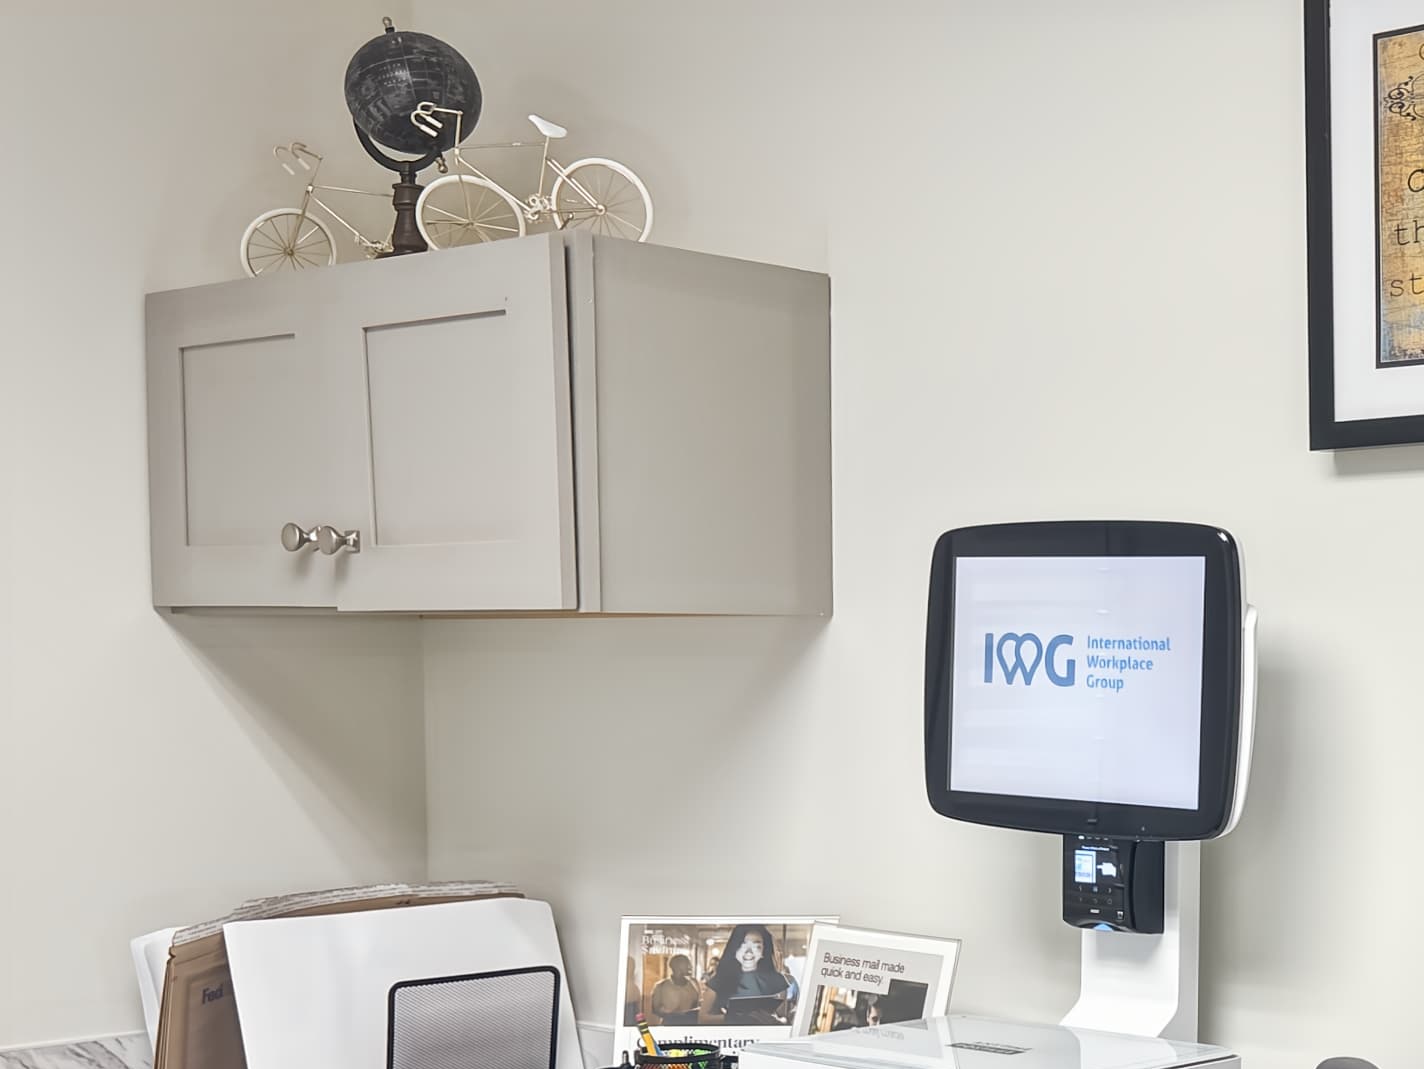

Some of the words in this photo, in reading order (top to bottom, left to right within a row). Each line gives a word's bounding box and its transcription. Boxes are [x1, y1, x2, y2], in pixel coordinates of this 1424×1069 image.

[1087, 635, 1172, 651] International
[984, 632, 1076, 687] IWG
[1086, 655, 1154, 673] Workplace
[1086, 674, 1124, 692] Group
[823, 952, 861, 967] Business
[862, 959, 880, 970] mail
[880, 962, 905, 973] made
[821, 967, 844, 978] quick
[844, 970, 862, 981] and
